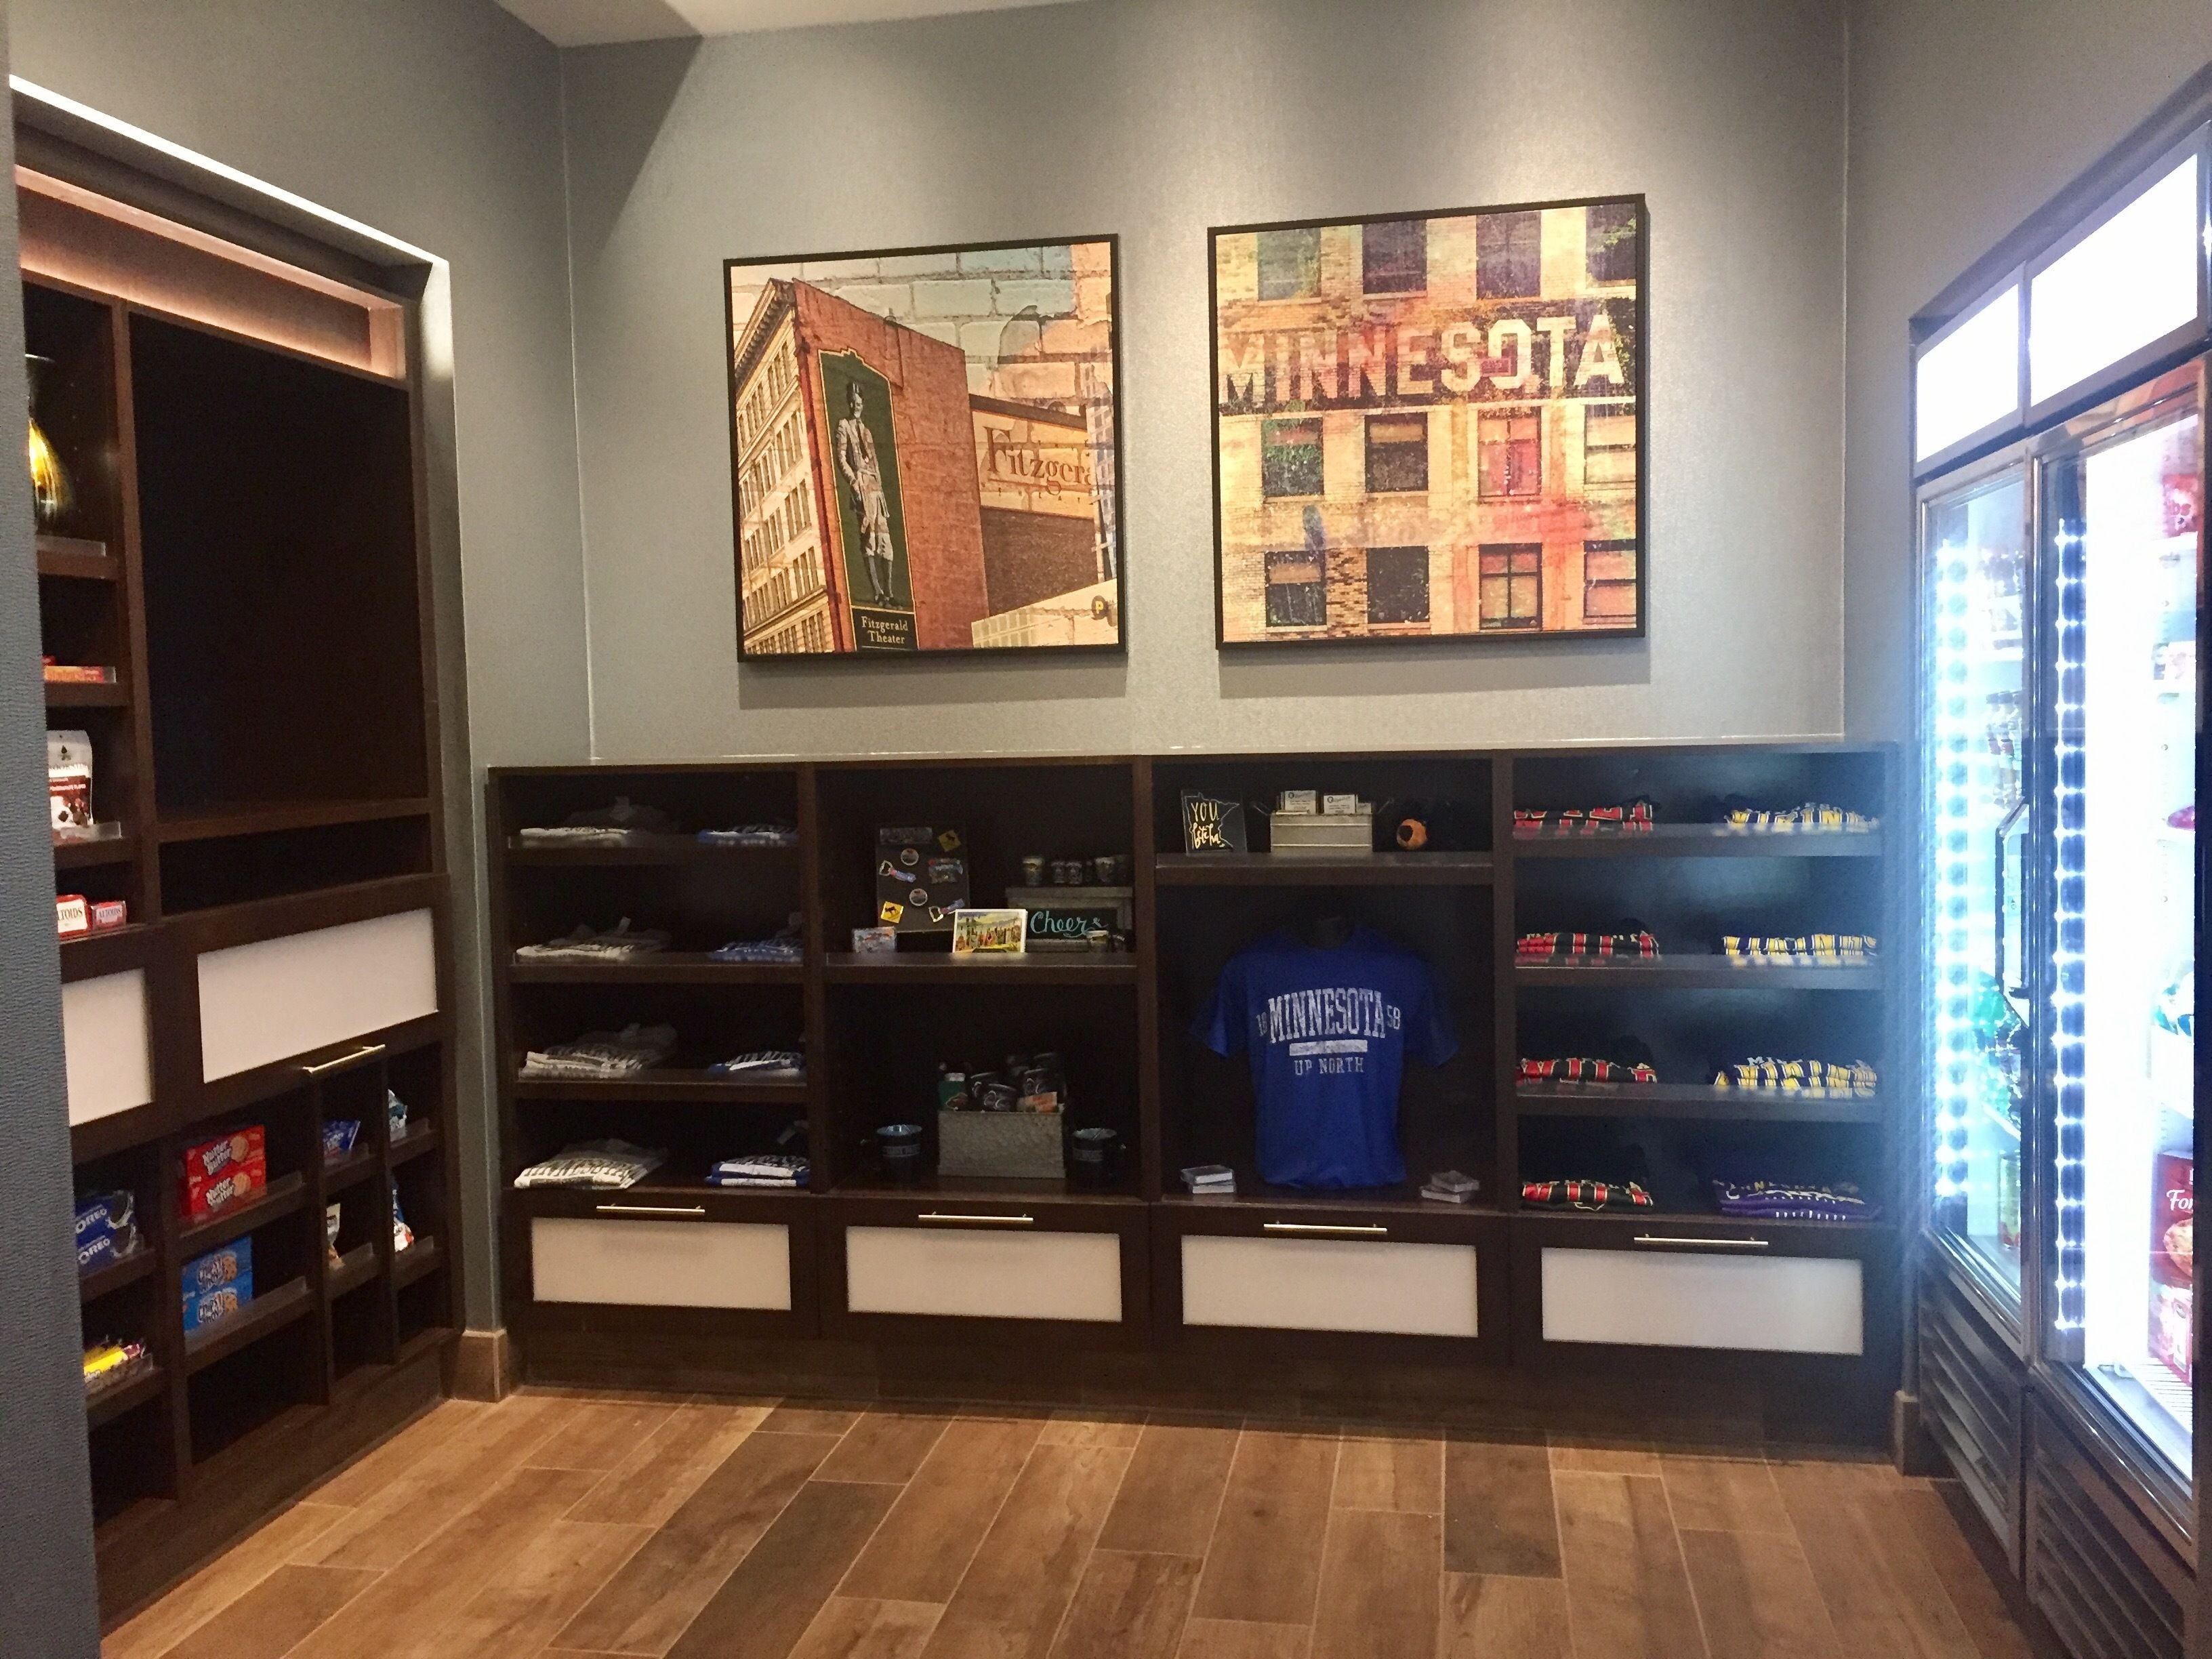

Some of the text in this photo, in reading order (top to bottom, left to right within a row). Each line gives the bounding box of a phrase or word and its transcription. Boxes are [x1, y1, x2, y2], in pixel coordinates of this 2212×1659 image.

[1220, 313, 1624, 404] MINNESOTA
[861, 616, 908, 633] Fitzgerald
[867, 630, 905, 644] Theater
[1191, 802, 1219, 821] YOU
[1268, 987, 1385, 1043] MINNESOTA
[1294, 1057, 1364, 1076] UP NORTH
[76, 1208, 107, 1233] OREO
[79, 1237, 110, 1265] OREO
